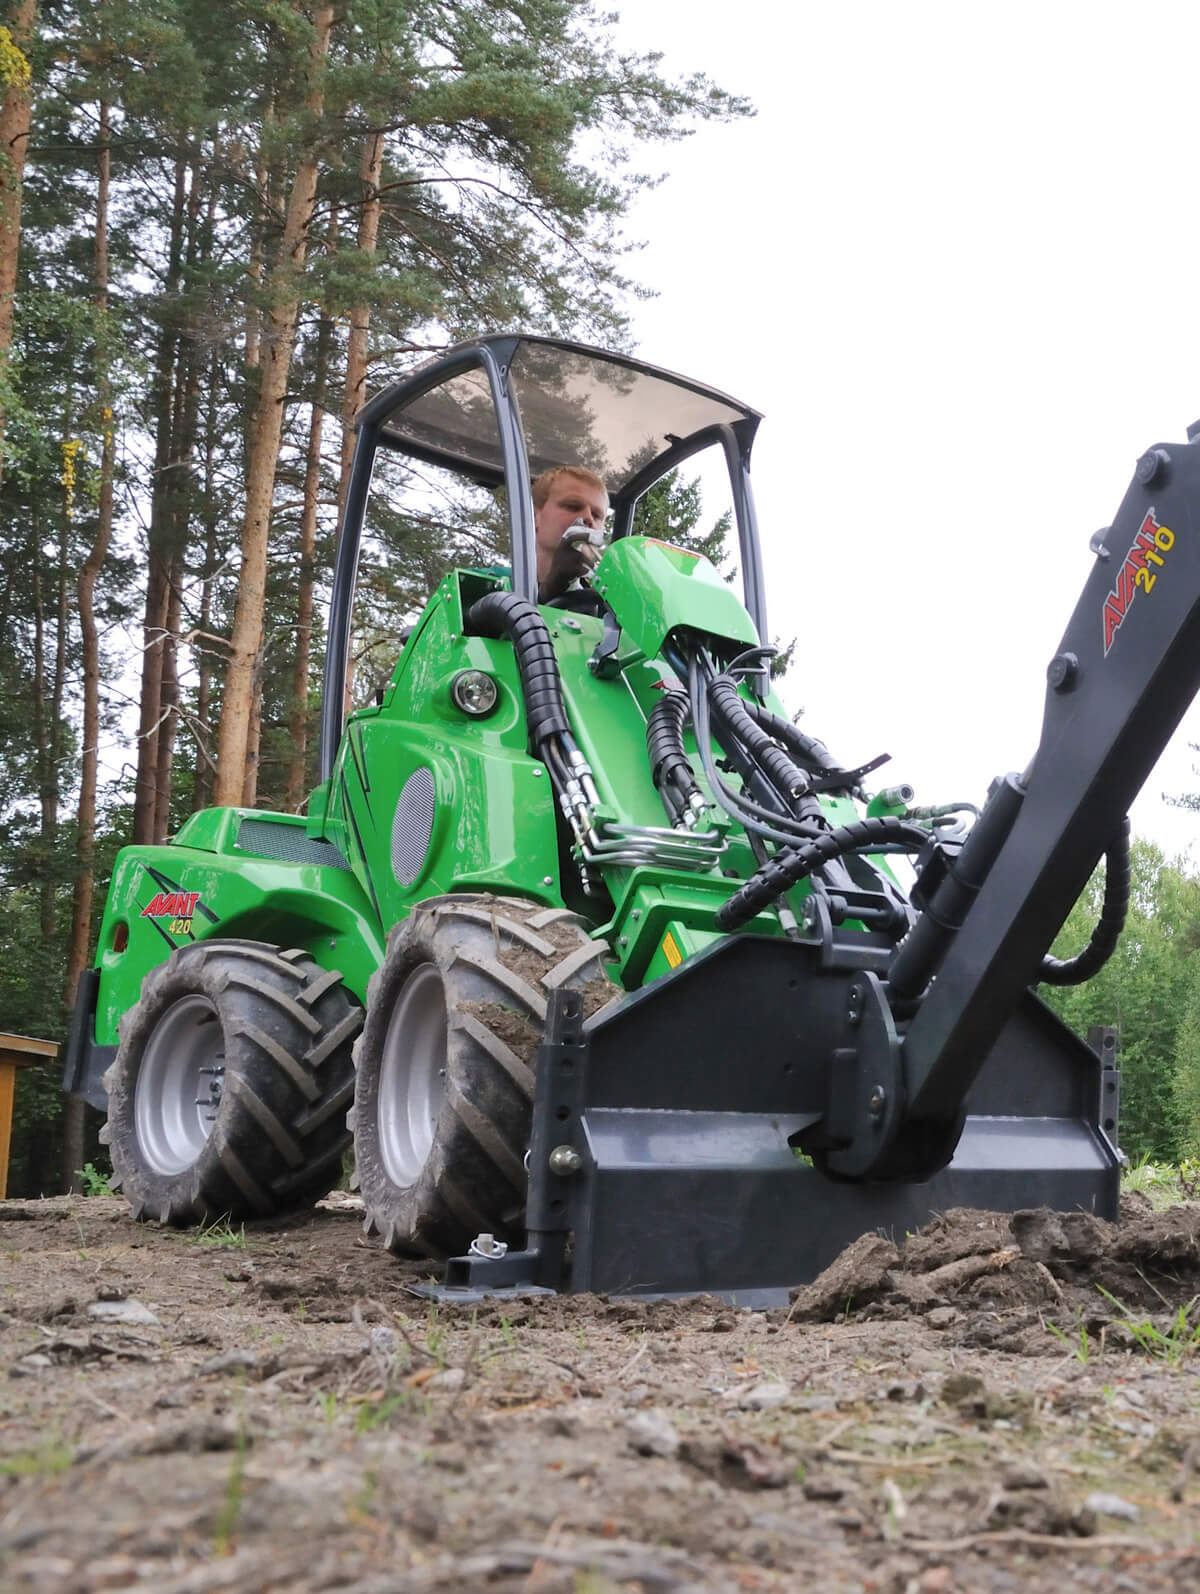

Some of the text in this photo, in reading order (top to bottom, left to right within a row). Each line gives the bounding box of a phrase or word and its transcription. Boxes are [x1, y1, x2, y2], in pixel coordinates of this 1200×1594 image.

[1103, 506, 1160, 658] AVANT
[1135, 526, 1175, 594] 210
[139, 892, 202, 918] AVANT
[169, 919, 191, 934] 420
